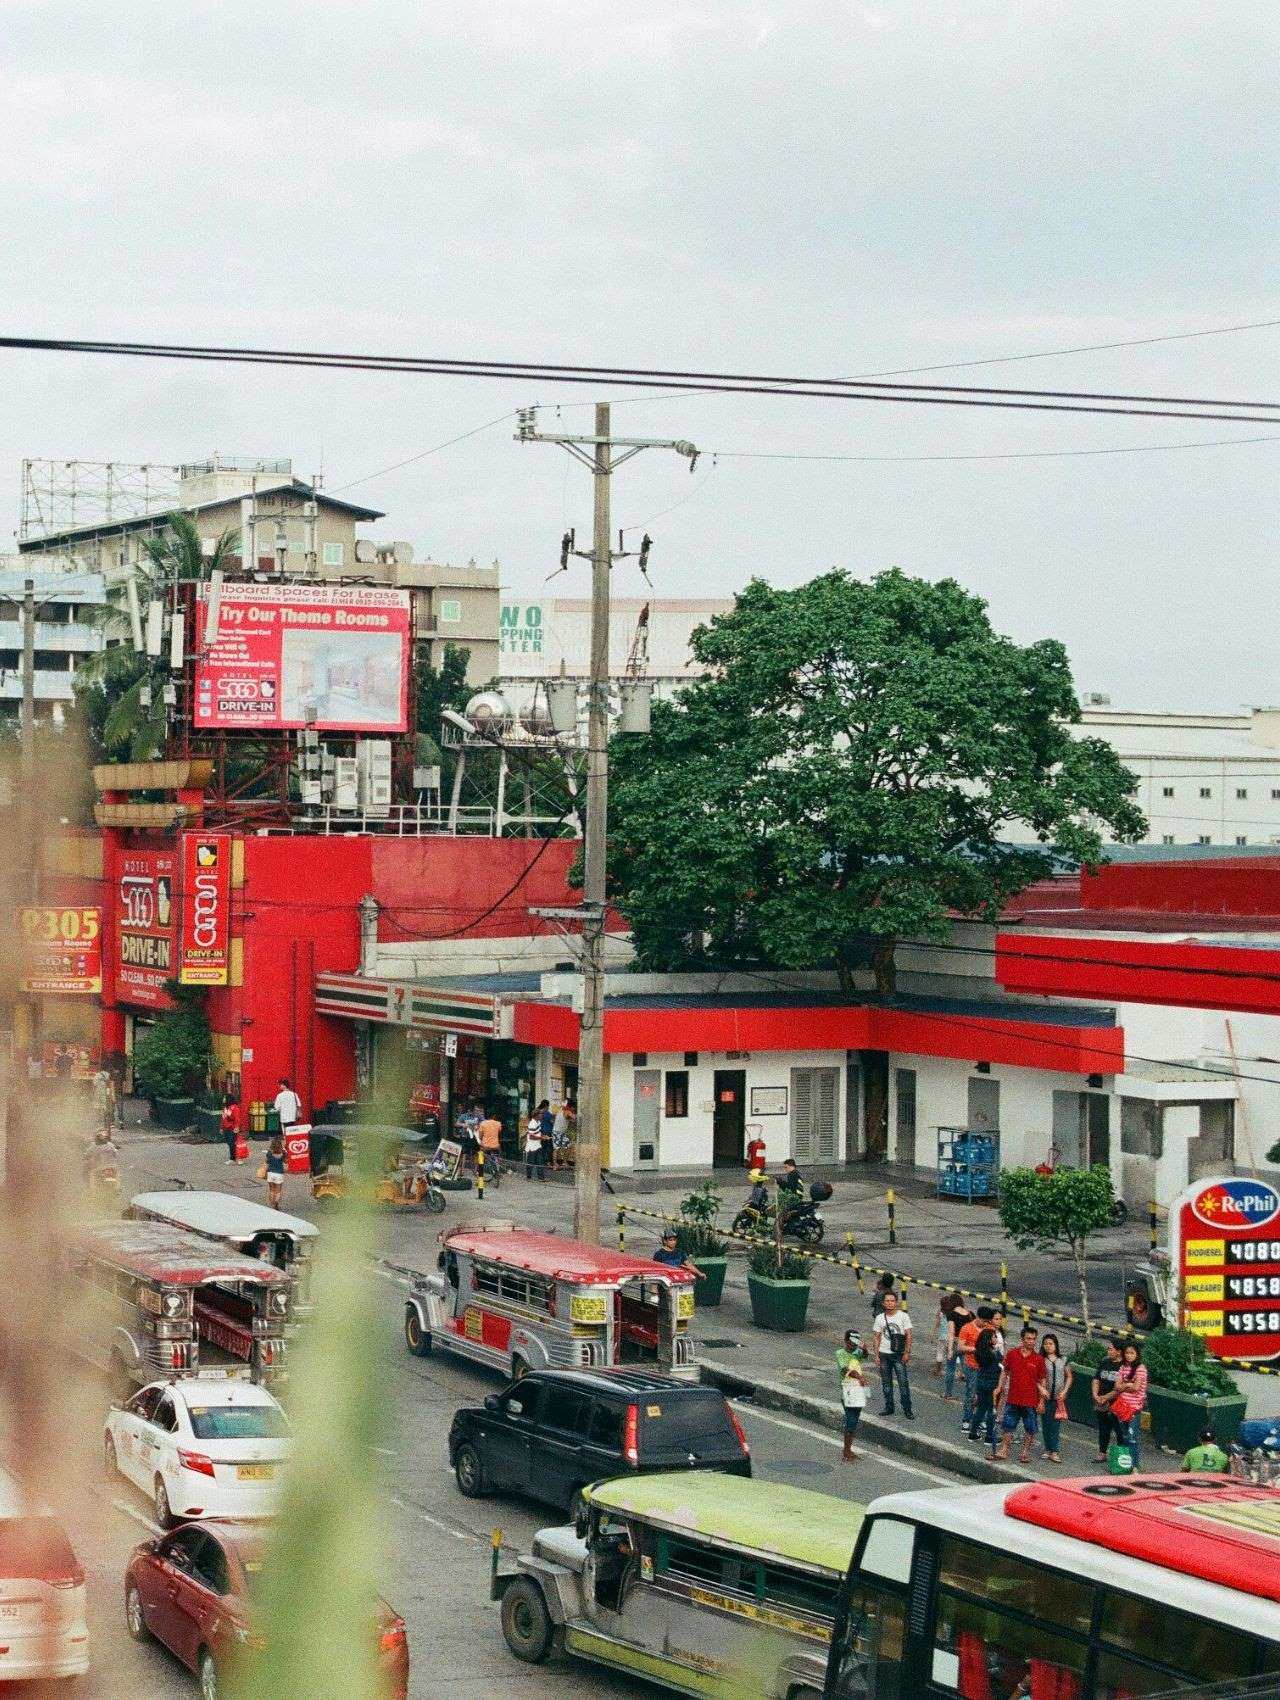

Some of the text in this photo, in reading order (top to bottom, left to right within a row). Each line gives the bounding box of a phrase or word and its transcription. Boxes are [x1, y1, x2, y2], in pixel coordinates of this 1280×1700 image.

[274, 586, 328, 596] Spaces
[333, 589, 353, 597] For
[358, 591, 399, 599] Lease
[221, 606, 389, 626] Try Our Theme Rooms
[220, 701, 274, 711] DRIVE-IN
[194, 875, 218, 947] SOGO
[121, 934, 170, 968] DRIVE-IN
[1221, 1195, 1275, 1213] RePhil
